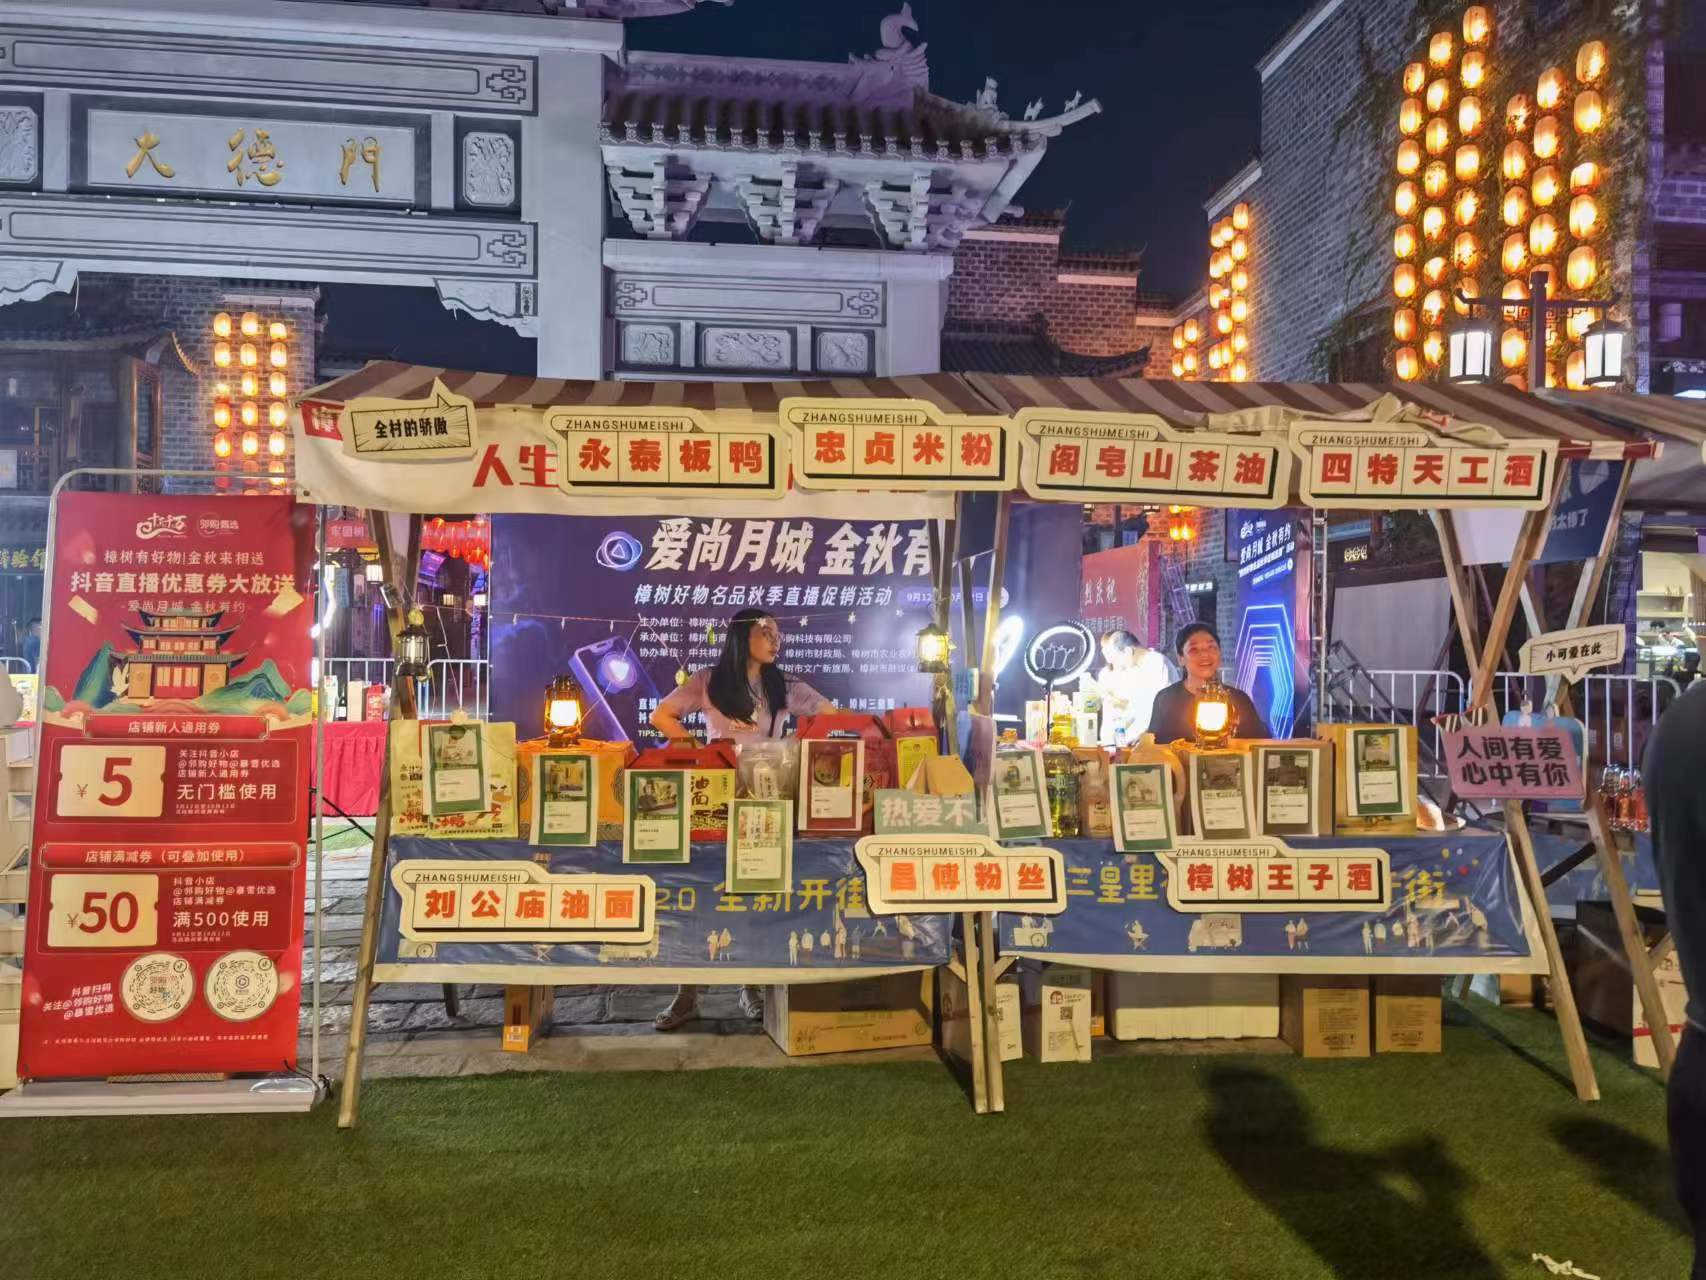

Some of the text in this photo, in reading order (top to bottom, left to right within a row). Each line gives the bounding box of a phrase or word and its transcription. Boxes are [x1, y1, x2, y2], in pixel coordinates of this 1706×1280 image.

[374, 416, 449, 439] 全村的骄傲
[566, 418, 685, 431] ZHANGSHUMEISHI
[803, 411, 918, 425] ZHANGSHUMEISHI
[1039, 424, 1151, 440] ZHANGSHUMEISHI
[1312, 434, 1420, 447] ZHANGSHUMEISHI
[579, 438, 763, 474] 永泰板鸭
[815, 431, 993, 466] 忠贞米粉
[1048, 443, 1267, 484] 阁皂山茶油
[1321, 453, 1535, 486] 四特天工酒
[645, 519, 812, 573] 爱尚月城
[70, 572, 296, 594] 抖音直播优惠券大放送
[634, 584, 892, 606] 樟树好物名品秋季直播促销活动
[1546, 643, 1602, 663] 小可爱在此
[127, 720, 221, 735] 店铺新人通用券
[1457, 735, 1566, 761] 人间有爱
[1462, 762, 1571, 787] 心中有你
[177, 783, 277, 801] 无门槛使用
[879, 846, 978, 856] ZHANGSHUMEISHI
[415, 872, 521, 883] ZHANGSHUMEISHI
[890, 862, 1045, 891] 昌傅粉丝
[1067, 863, 1159, 903] 三皇里
[1187, 863, 1373, 892] 樟树王子酒
[425, 890, 635, 921] 刘公庙油面
[656, 887, 696, 912] 2.0
[173, 911, 269, 928] 满500使用
